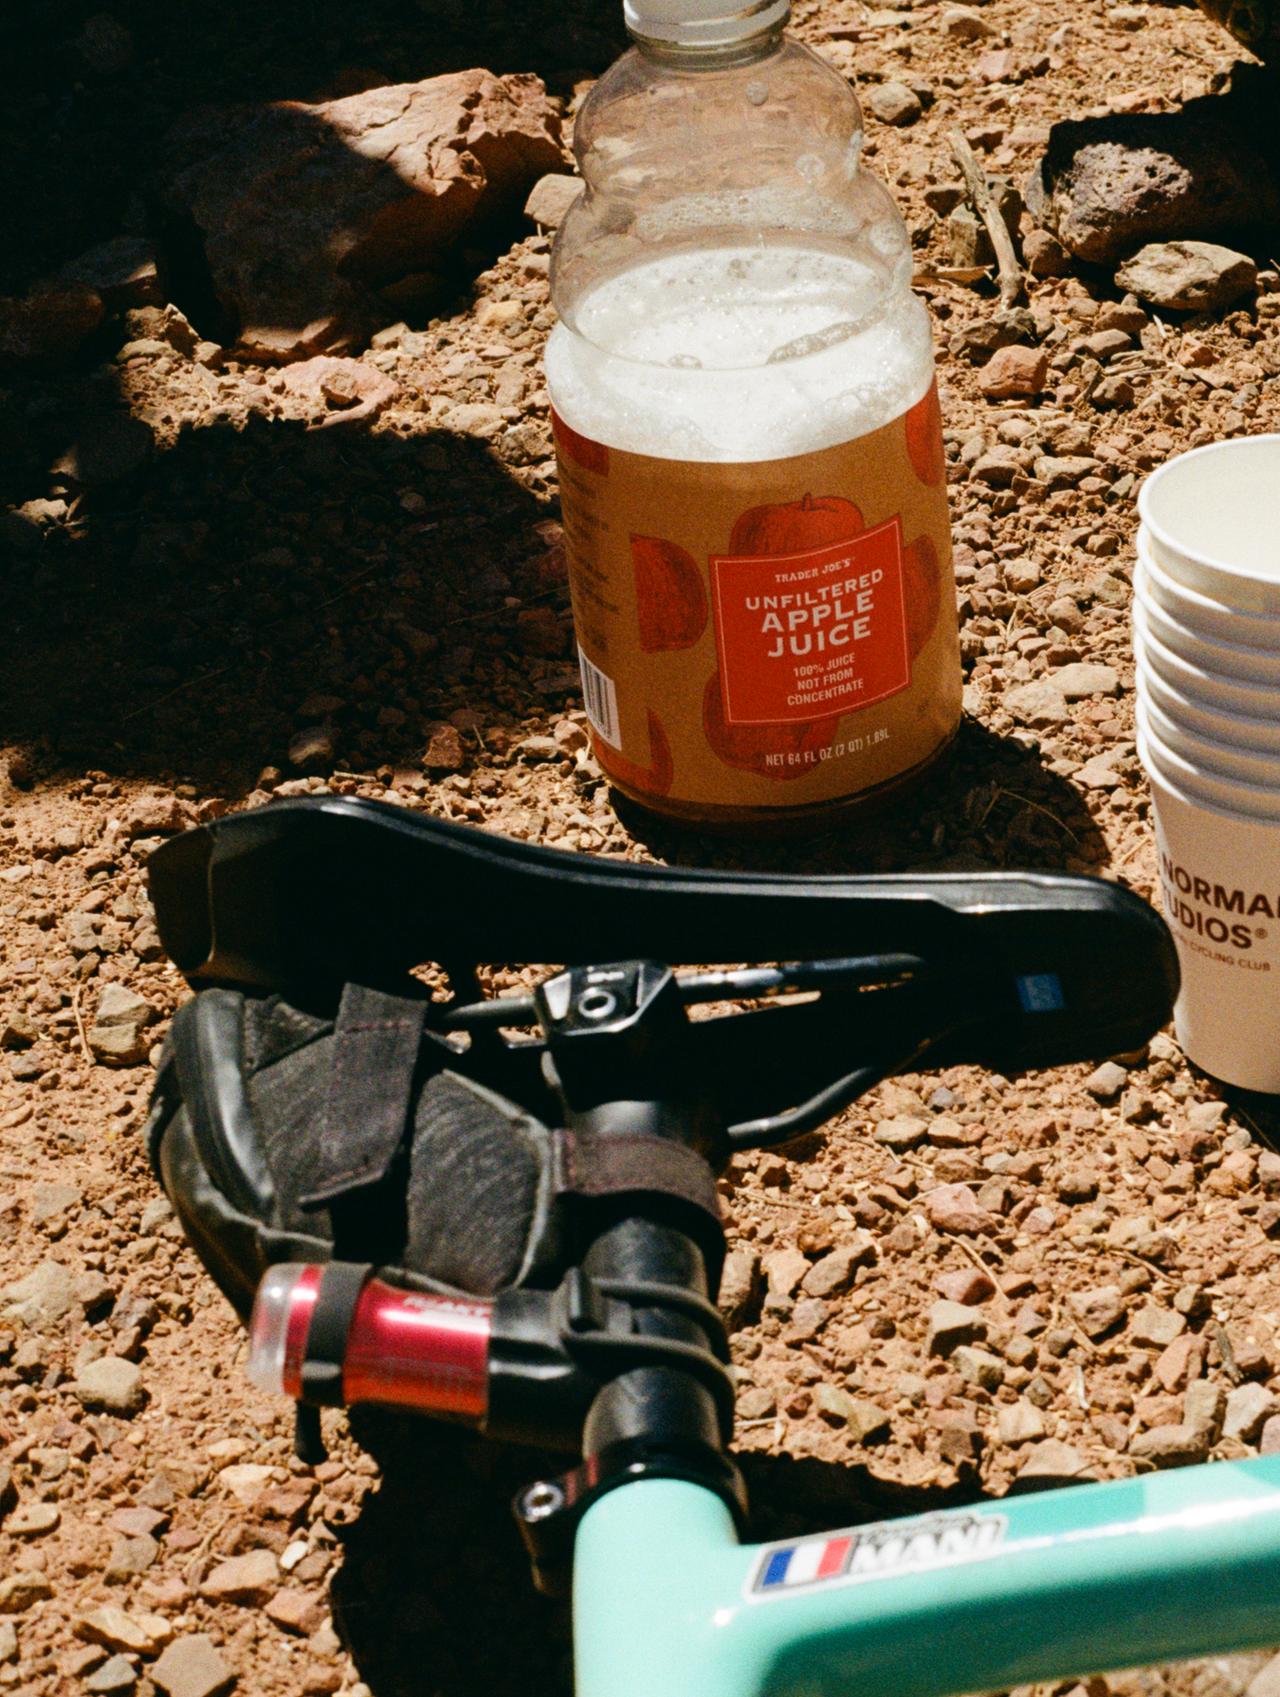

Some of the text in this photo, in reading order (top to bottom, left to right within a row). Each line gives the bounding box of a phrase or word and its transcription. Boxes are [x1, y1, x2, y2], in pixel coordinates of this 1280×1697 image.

[774, 557, 851, 583] TRADER JOE'S
[745, 568, 884, 611] UNFILTERED
[761, 589, 875, 634] APPLE
[767, 616, 872, 658] JUICE
[793, 652, 856, 678] 100% JUICE
[797, 667, 854, 691] NOT FROM
[787, 678, 864, 706] CONCENTRATE
[765, 754, 785, 767] NET
[787, 752, 801, 766] 64
[804, 751, 817, 763] FL
[819, 747, 833, 761] OZ
[835, 743, 845, 758] (2
[848, 737, 864, 753] QT)
[1190, 941, 1271, 972] CYCLING CLUB
